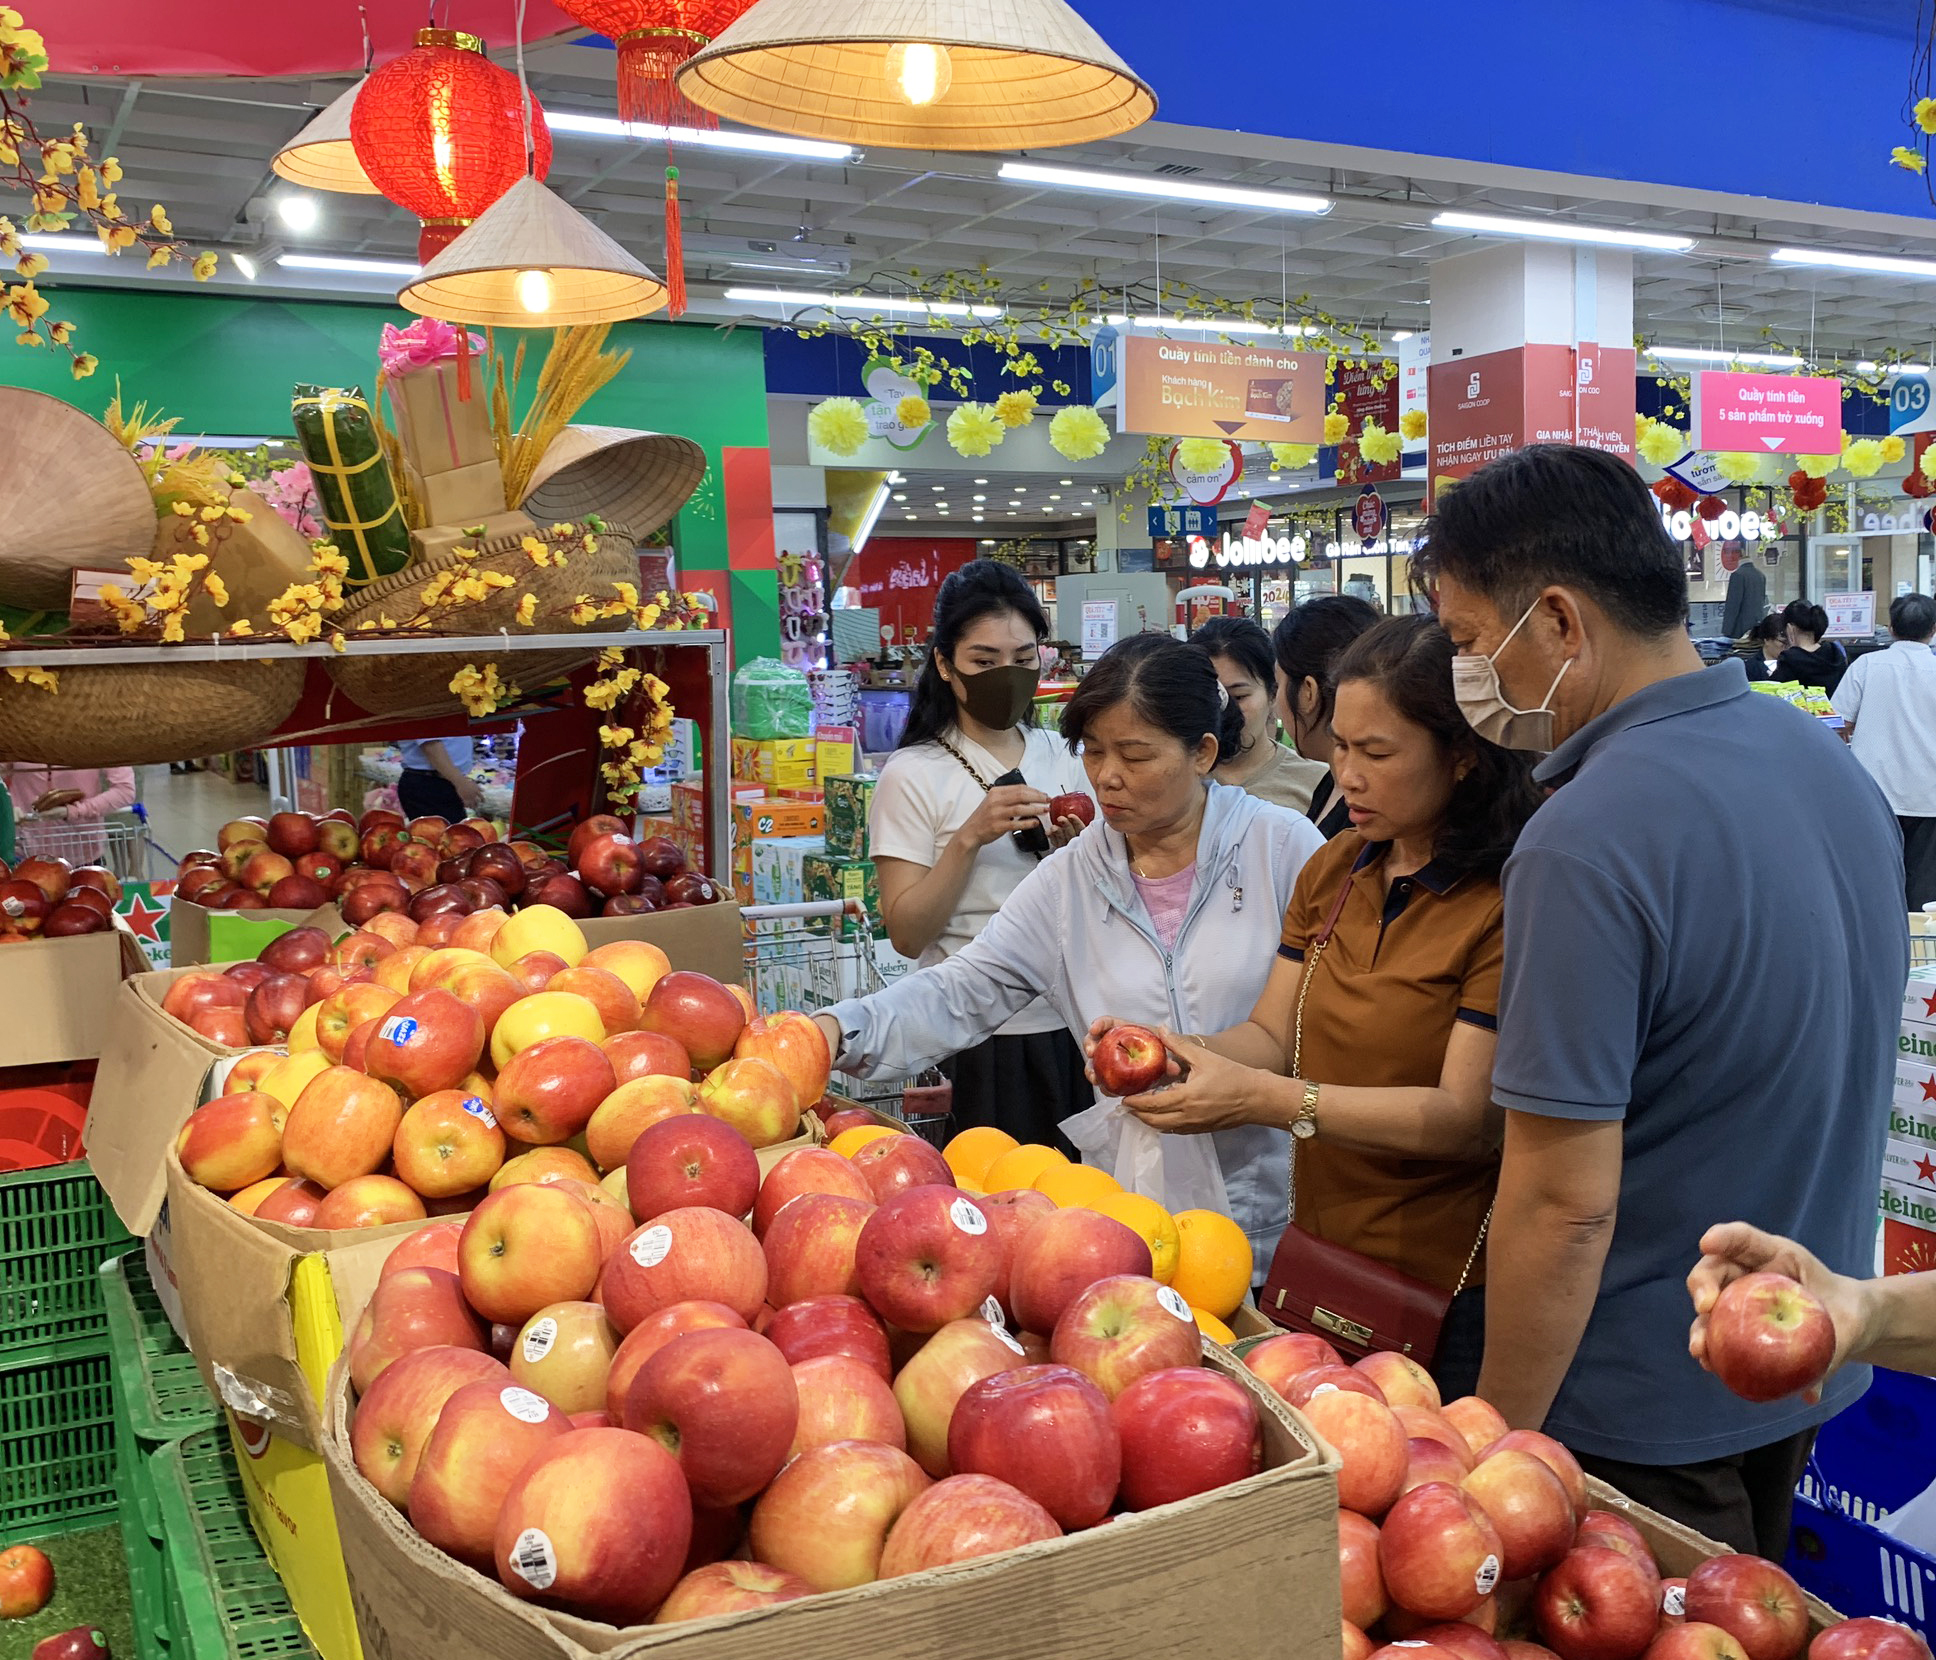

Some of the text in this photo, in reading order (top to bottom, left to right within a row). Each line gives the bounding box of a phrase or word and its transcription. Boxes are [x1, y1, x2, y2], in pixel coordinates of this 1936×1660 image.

[1158, 345, 1299, 371] Quầy tính tiền dành cho
[1162, 375, 1208, 389] Khách hàng
[1162, 385, 1204, 409] Bạch
[1738, 386, 1806, 404] Quầy tính tiền
[1895, 383, 1926, 412] 03
[1719, 408, 1825, 428] 5 sản phẩm trở xuống
[1436, 441, 1456, 454] TÍCH
[1499, 433, 1514, 445] TAY
[1536, 430, 1551, 440] GIA
[1436, 454, 1459, 468] NHẬN
[1460, 451, 1483, 464] NGAY
[1186, 473, 1205, 483] cảm
[757, 817, 774, 833] C2
